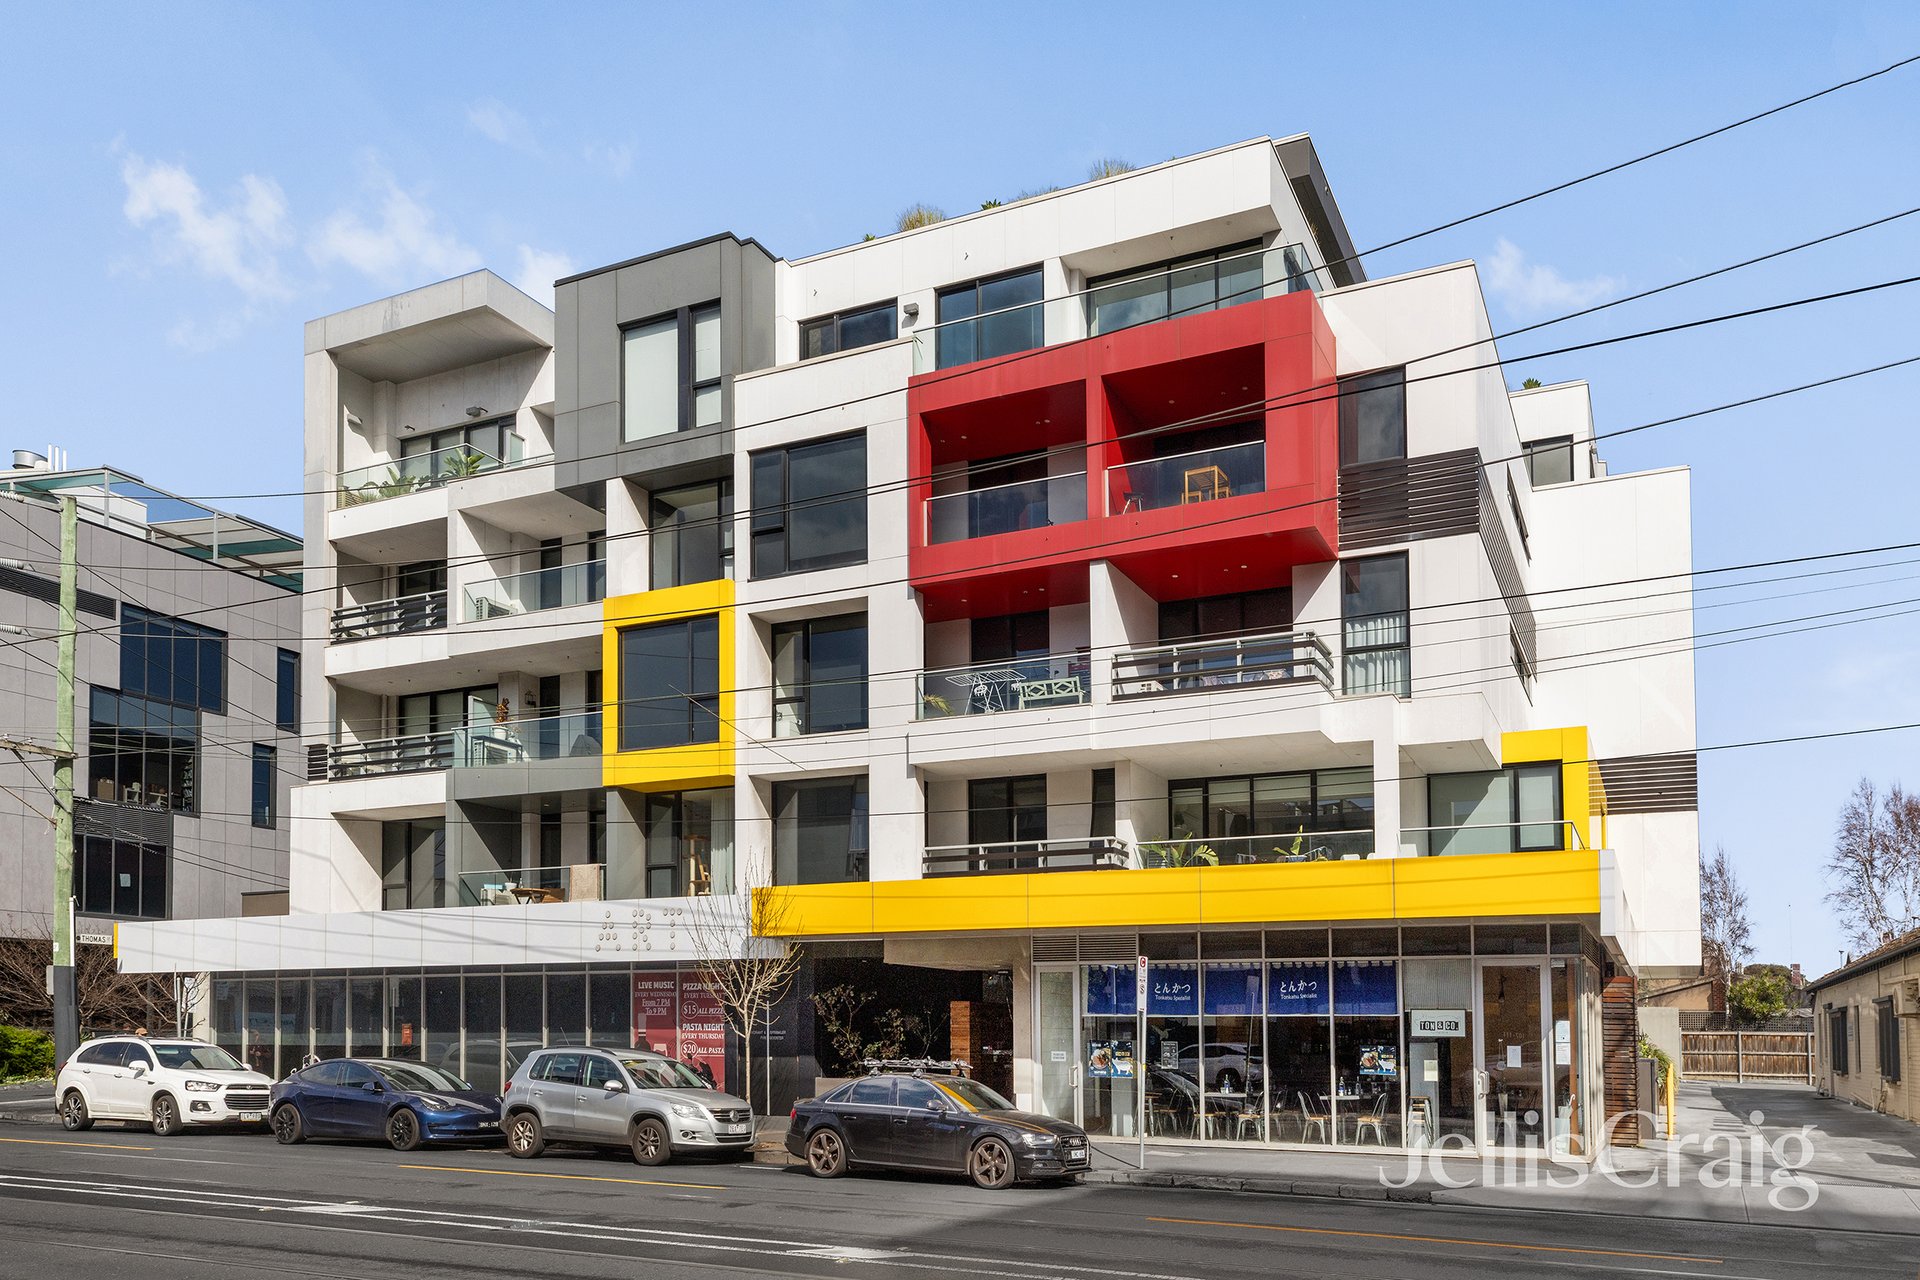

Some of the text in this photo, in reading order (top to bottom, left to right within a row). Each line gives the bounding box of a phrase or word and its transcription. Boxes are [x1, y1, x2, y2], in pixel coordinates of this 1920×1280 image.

[82, 935, 106, 943] THOMAS
[638, 981, 675, 989] LIVE MUSIC
[1154, 982, 1191, 994] とんかつ
[1280, 980, 1317, 993] とんかつ
[683, 1005, 697, 1014] $15
[682, 1023, 725, 1031] PASTA NIGHT
[1420, 1021, 1459, 1030] TON & CO.
[683, 1044, 696, 1054] $20
